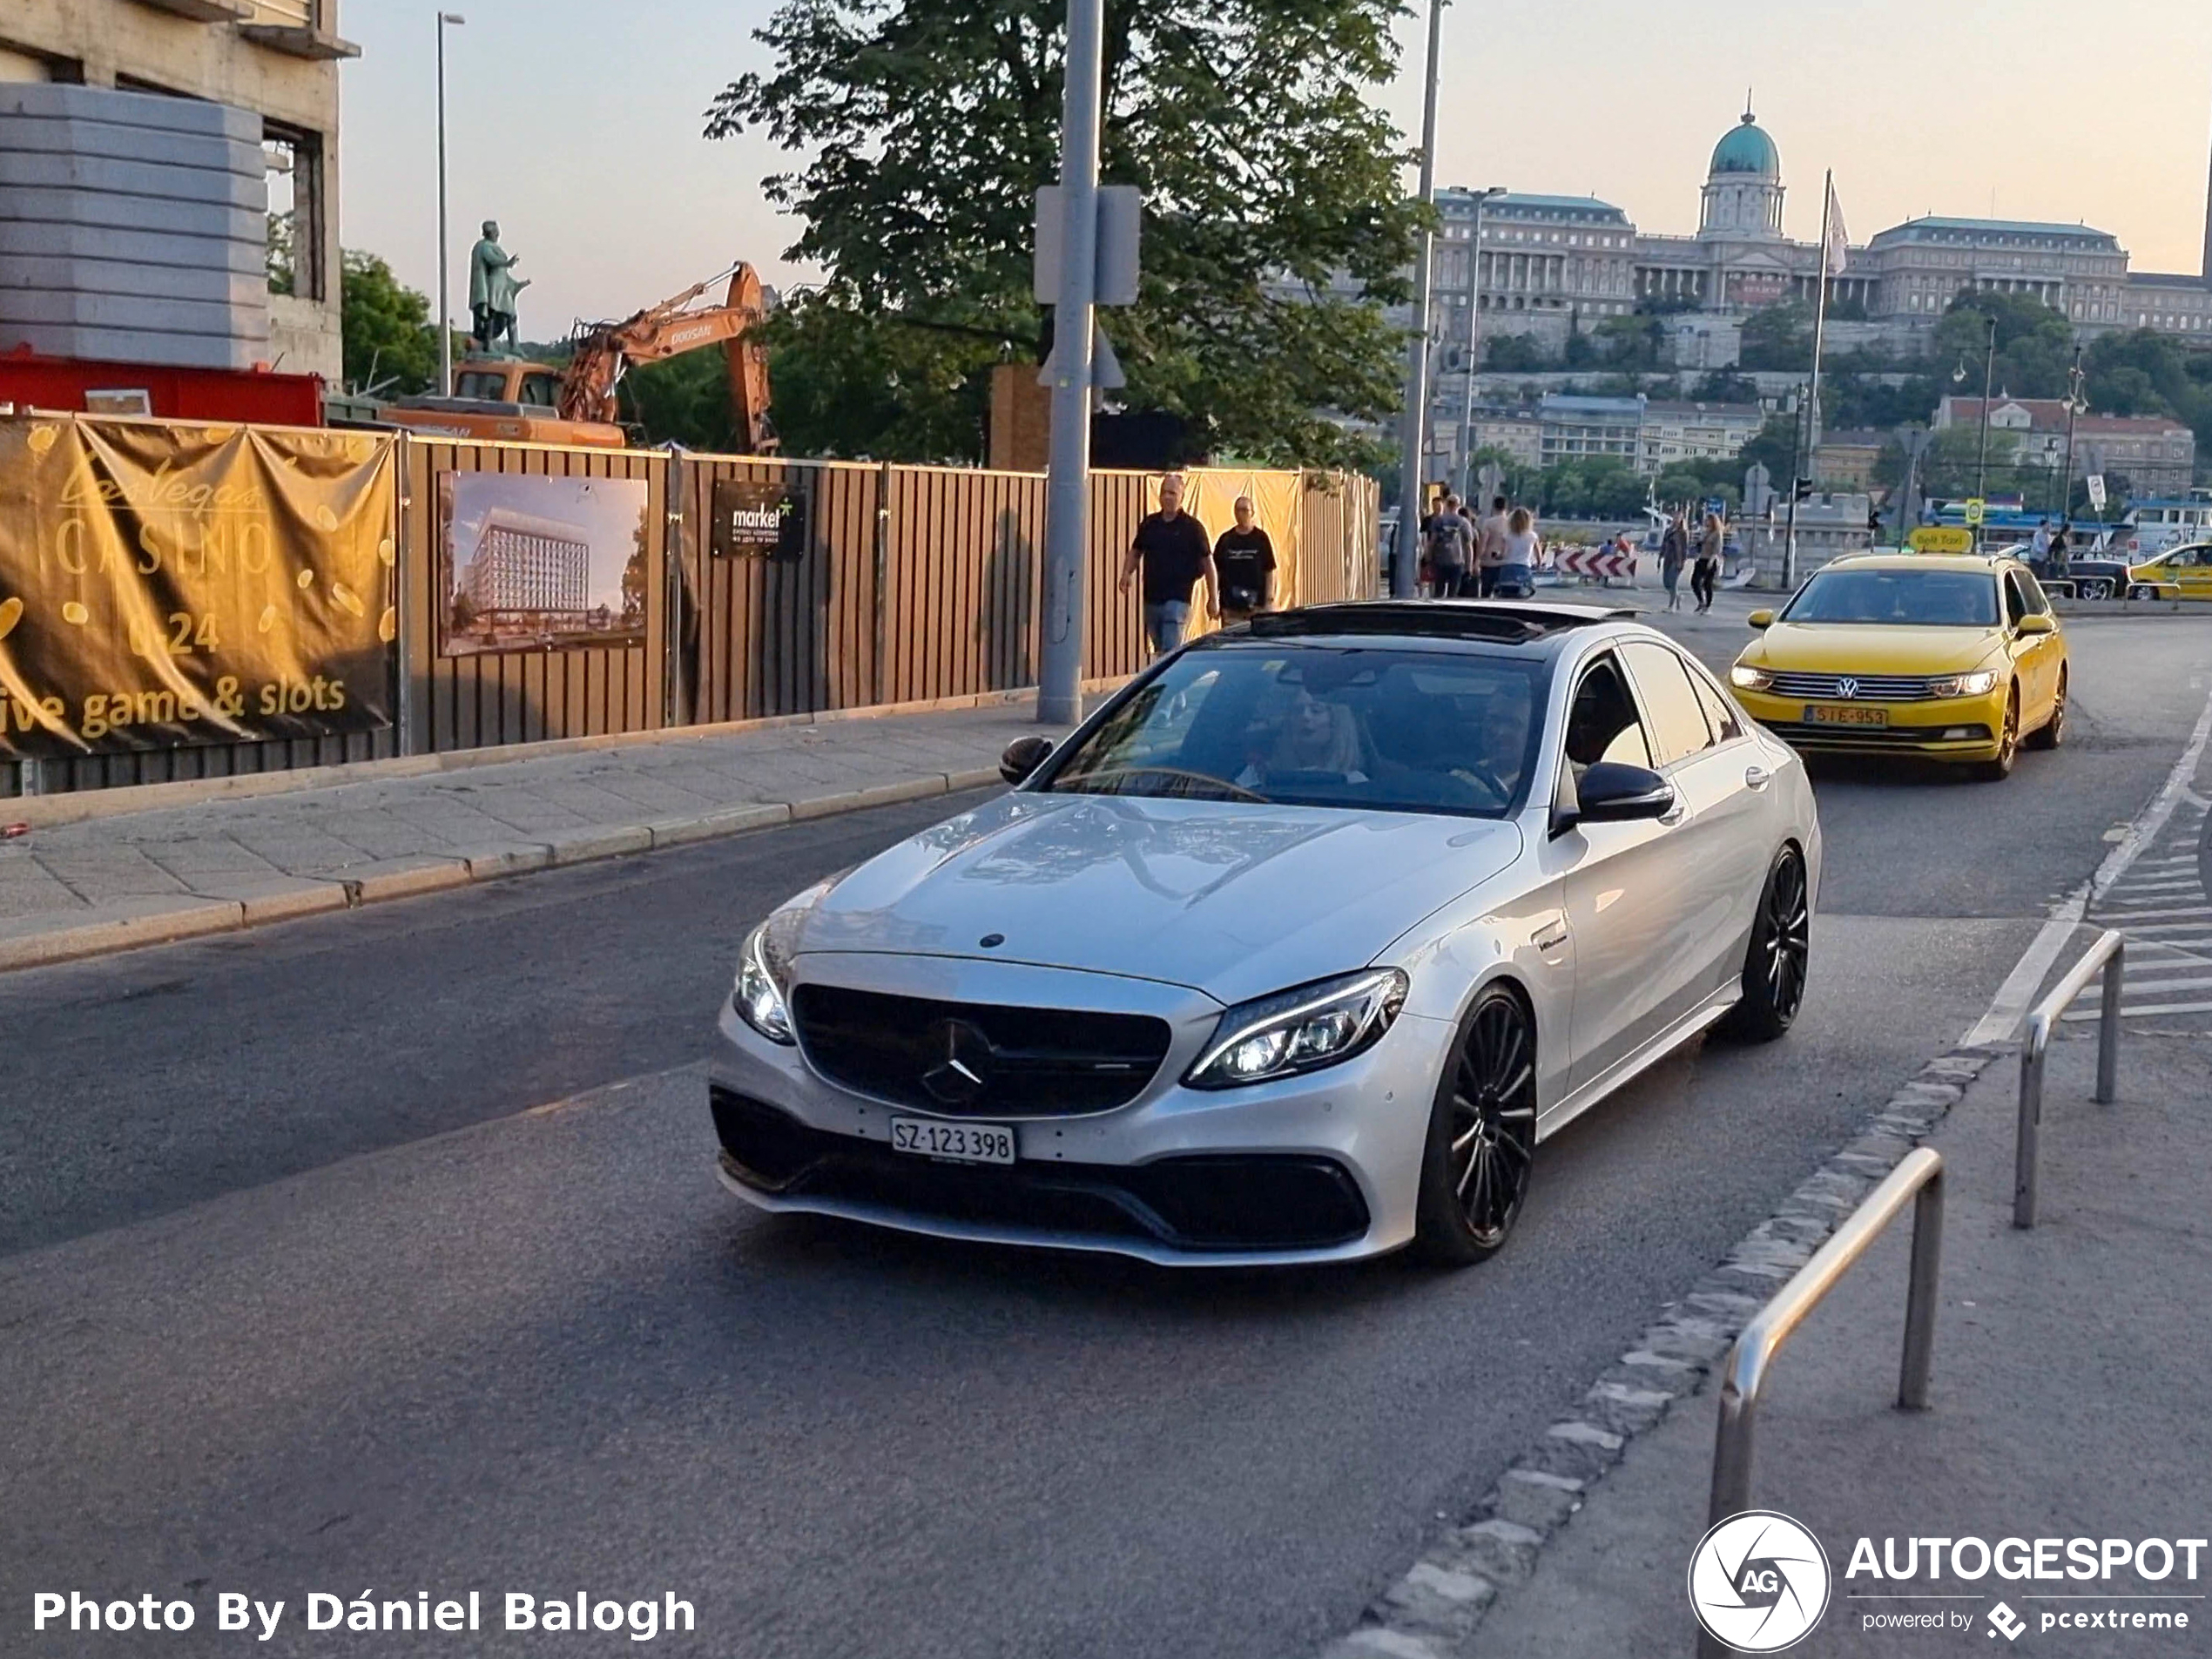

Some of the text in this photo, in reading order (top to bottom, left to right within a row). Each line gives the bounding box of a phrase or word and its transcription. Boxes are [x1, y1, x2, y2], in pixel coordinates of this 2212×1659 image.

[732, 502, 780, 529] market
[55, 517, 273, 576] CASINO
[1940, 534, 1963, 545] Taxi
[81, 688, 201, 739] game
[211, 675, 246, 718] &
[259, 671, 345, 716] slots
